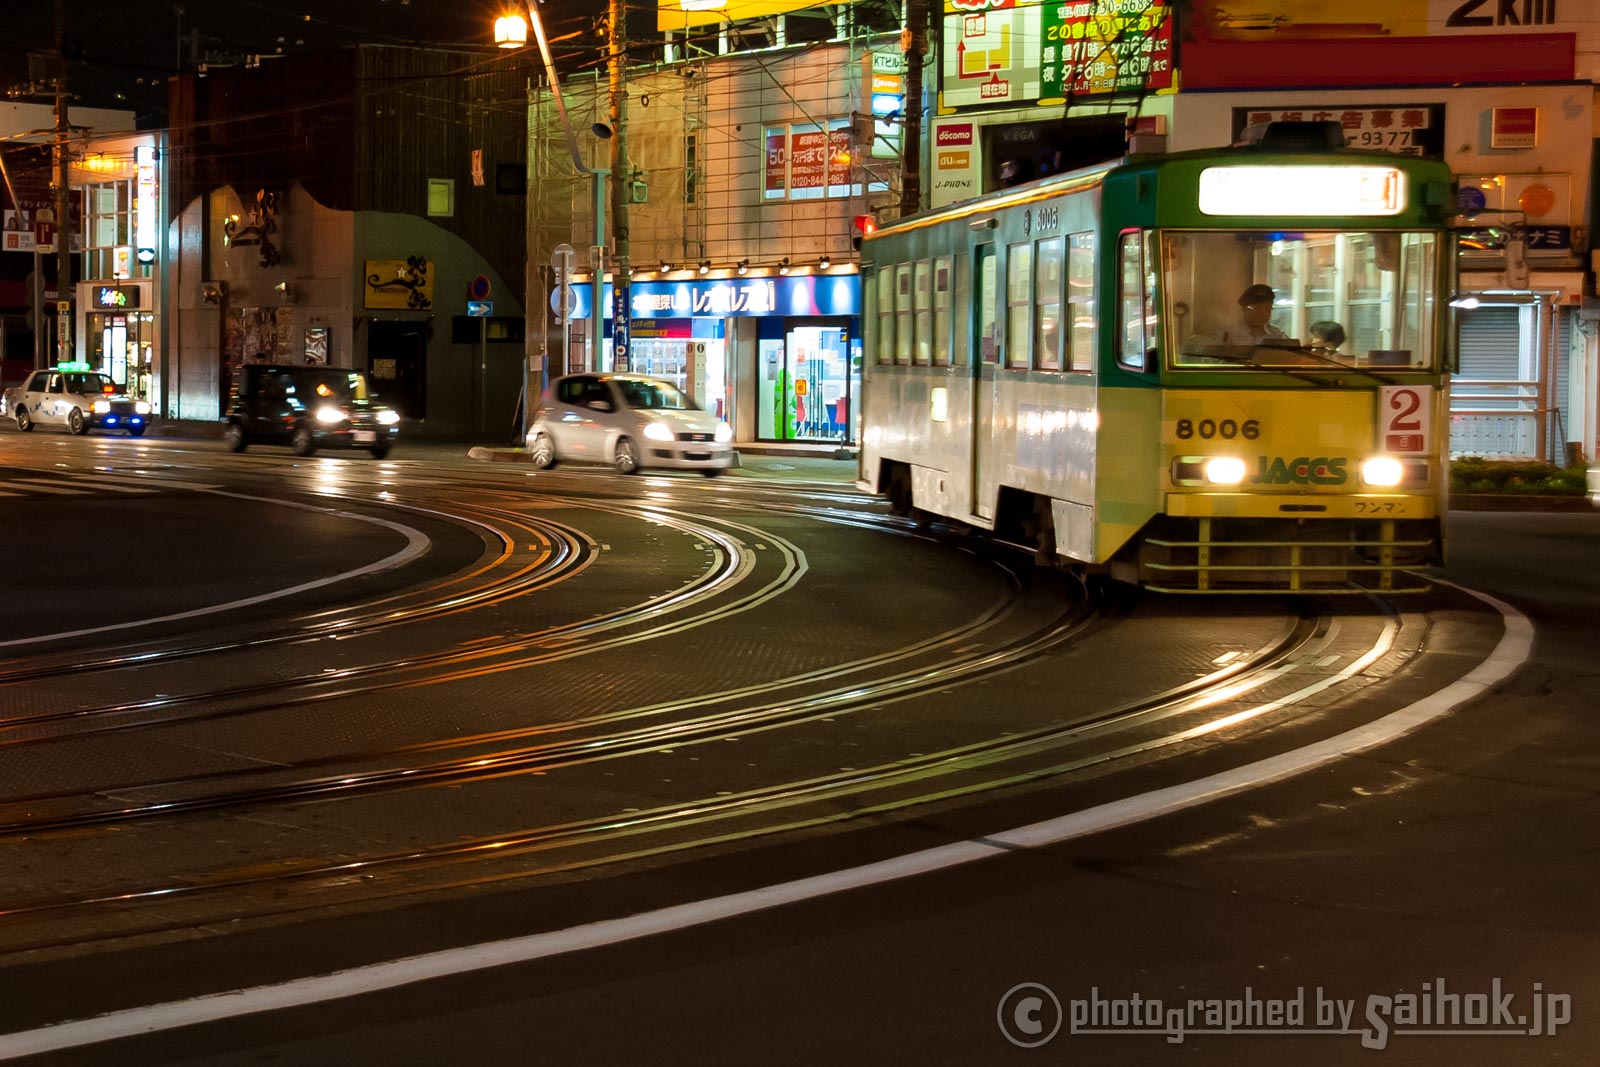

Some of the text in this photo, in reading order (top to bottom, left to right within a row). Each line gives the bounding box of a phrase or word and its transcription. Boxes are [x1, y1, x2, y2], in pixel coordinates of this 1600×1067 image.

[874, 55, 900, 68] KTビル
[939, 129, 970, 140] docomo
[935, 180, 972, 189] J-PHONE
[1389, 389, 1421, 431] 2
[1175, 419, 1260, 440] 8006
[1252, 456, 1347, 485] JACCS
[1354, 502, 1406, 514] ワンマン
